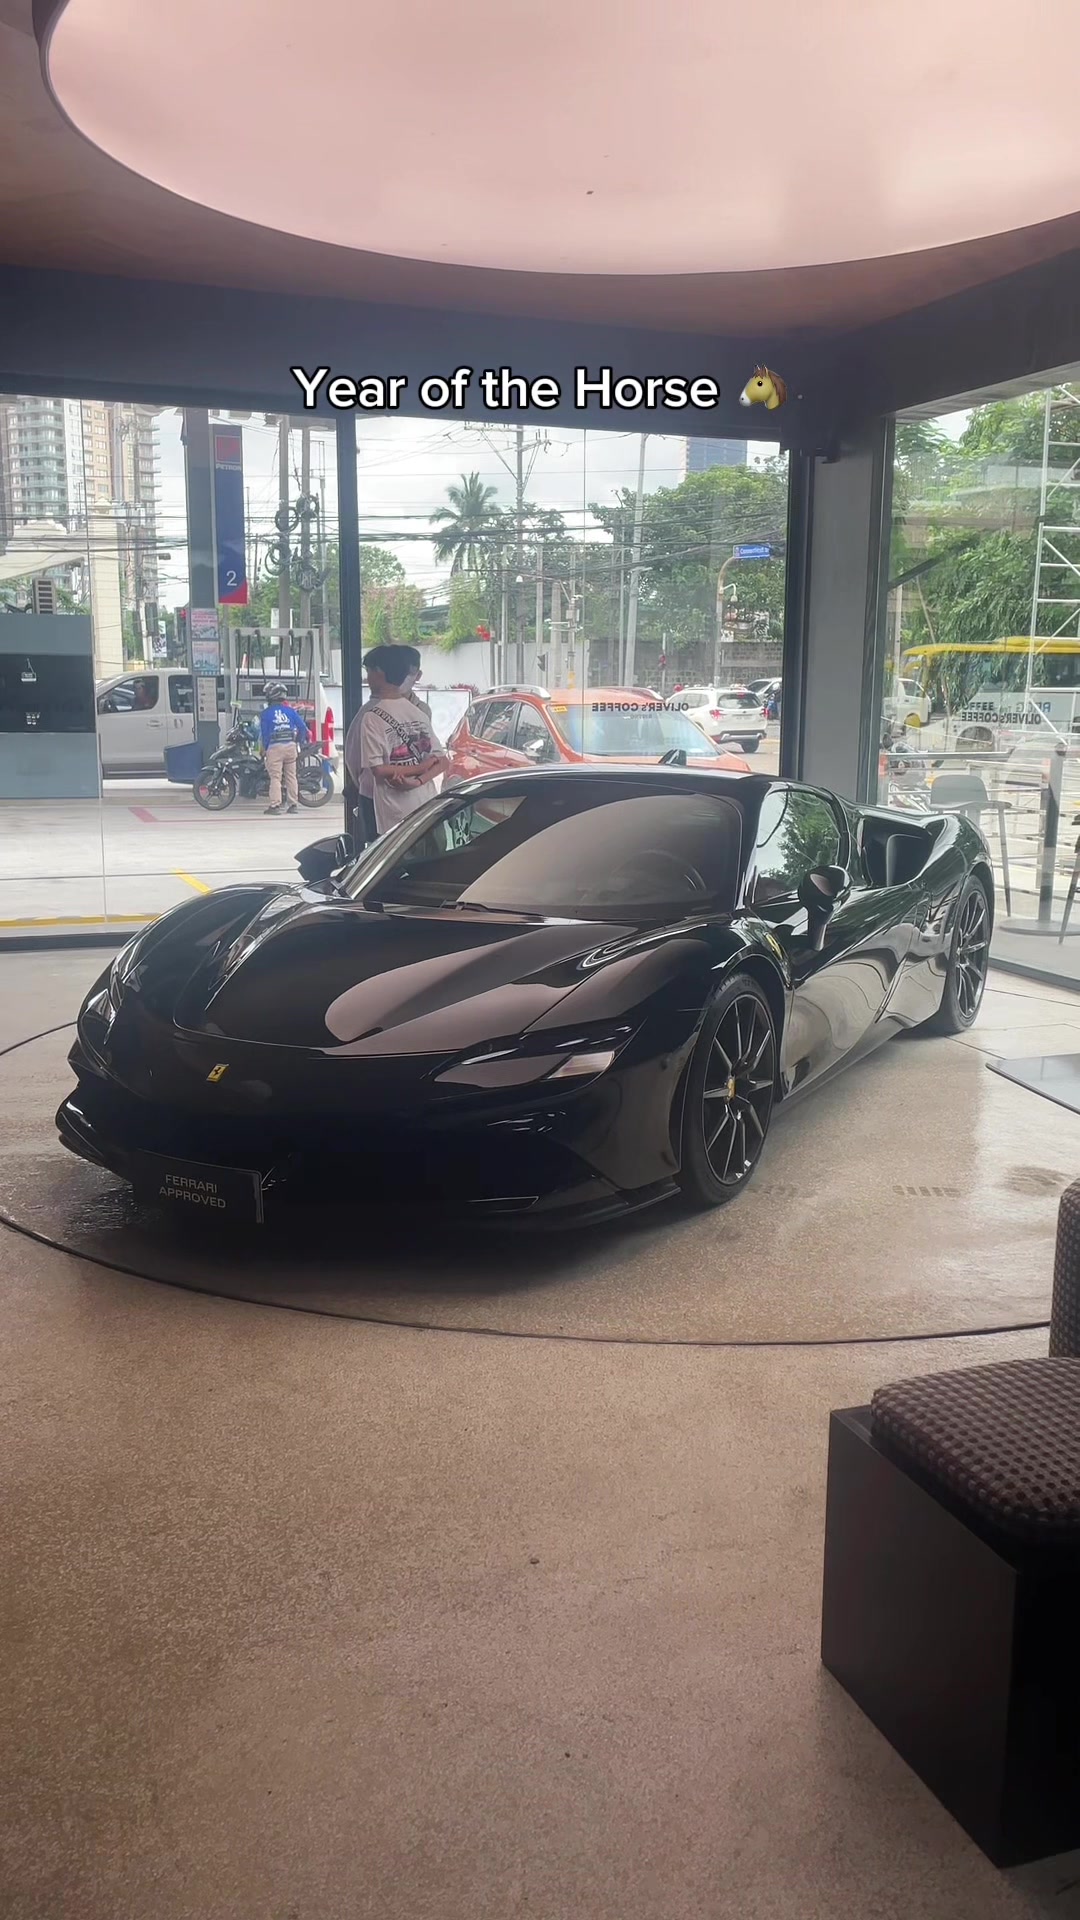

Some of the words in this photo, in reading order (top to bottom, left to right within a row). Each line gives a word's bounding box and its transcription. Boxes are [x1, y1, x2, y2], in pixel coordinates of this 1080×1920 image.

[226, 570, 238, 587] 2
[165, 1174, 218, 1194] FERRARI
[159, 1186, 227, 1209] APPROVED
